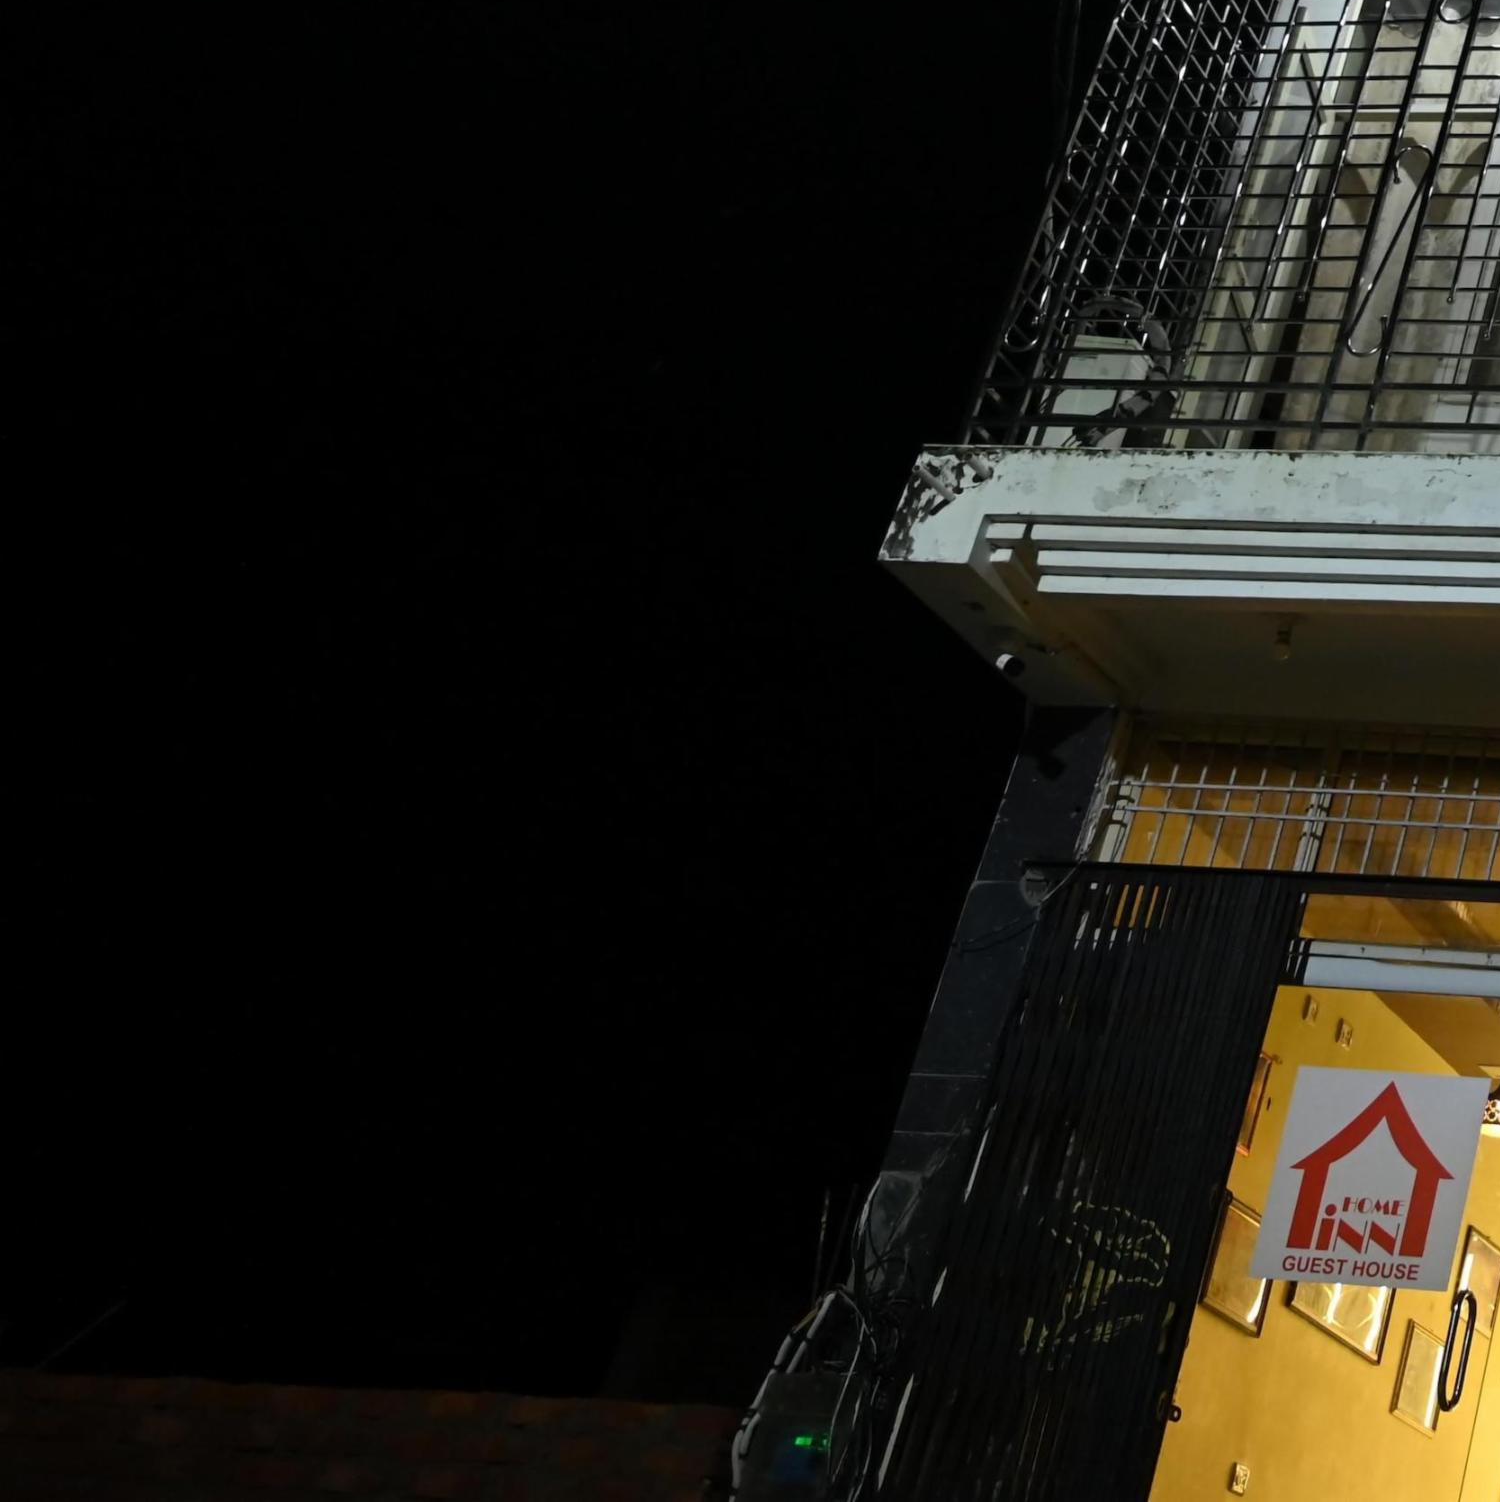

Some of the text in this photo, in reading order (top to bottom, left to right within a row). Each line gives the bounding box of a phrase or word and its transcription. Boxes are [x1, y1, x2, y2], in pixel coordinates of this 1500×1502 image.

[1342, 1196, 1406, 1217] HOME
[1281, 1254, 1421, 1281] GUEST HOUSE
